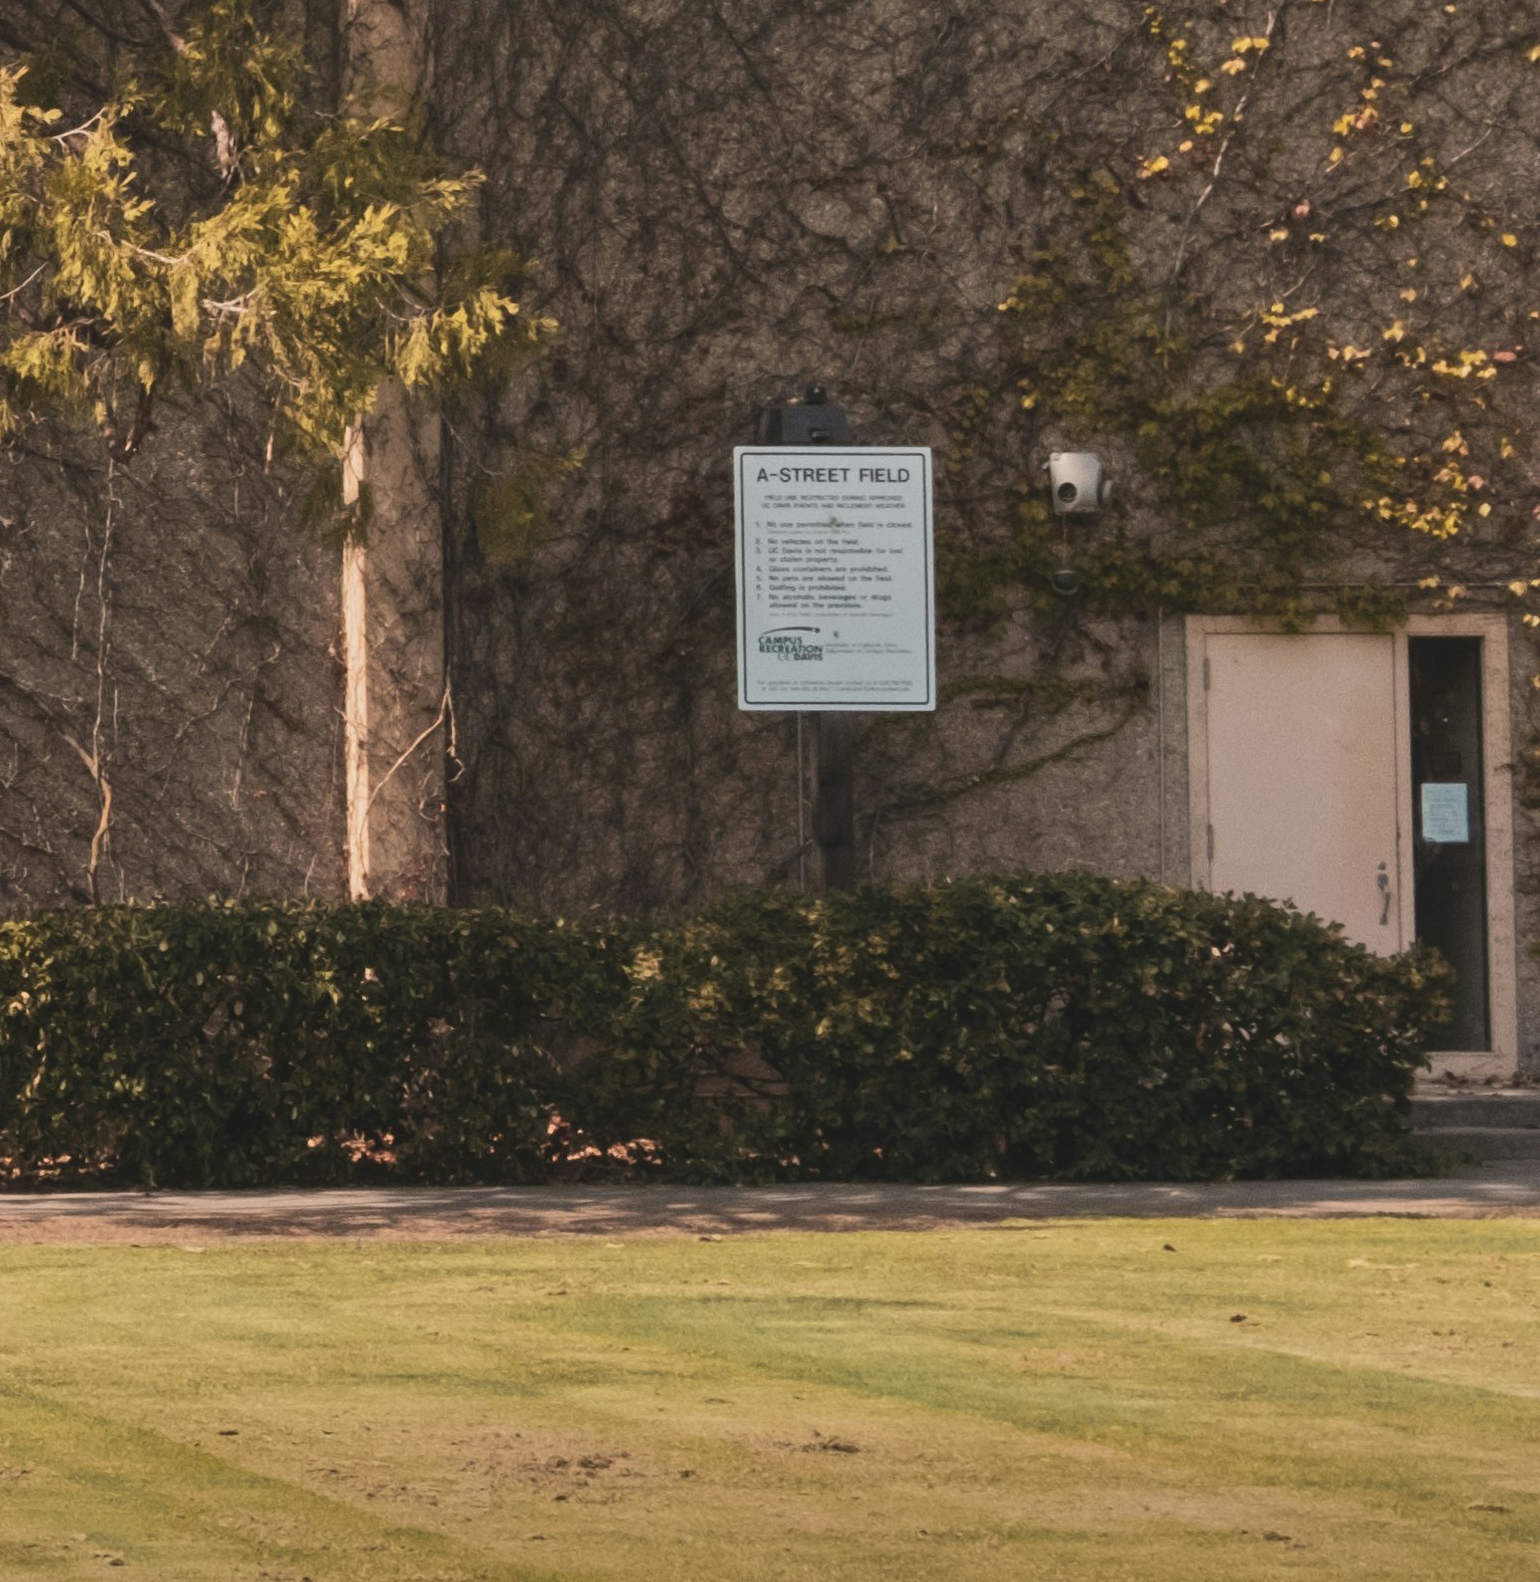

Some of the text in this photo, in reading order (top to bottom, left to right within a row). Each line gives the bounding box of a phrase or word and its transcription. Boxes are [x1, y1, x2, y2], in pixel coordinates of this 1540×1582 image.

[756, 468, 910, 483] A-STREET FIELD
[767, 521, 777, 529] No
[780, 521, 793, 529] use
[858, 521, 874, 529] field
[768, 538, 778, 546] No
[782, 538, 811, 546] vehicles
[814, 538, 823, 546] on
[826, 538, 838, 546] the
[768, 565, 790, 573] Glass
[793, 565, 832, 573] containers
[835, 565, 847, 573] are
[769, 584, 796, 592] Golfing
[798, 584, 805, 592] is
[768, 594, 779, 602] No
[783, 594, 815, 602] alcoholic
[818, 594, 856, 602] beverages
[861, 594, 868, 602] or
[870, 594, 892, 602] drugs
[758, 636, 802, 645] CAMPUS
[759, 644, 823, 654] RECREATION
[794, 652, 823, 662] DAVIS
